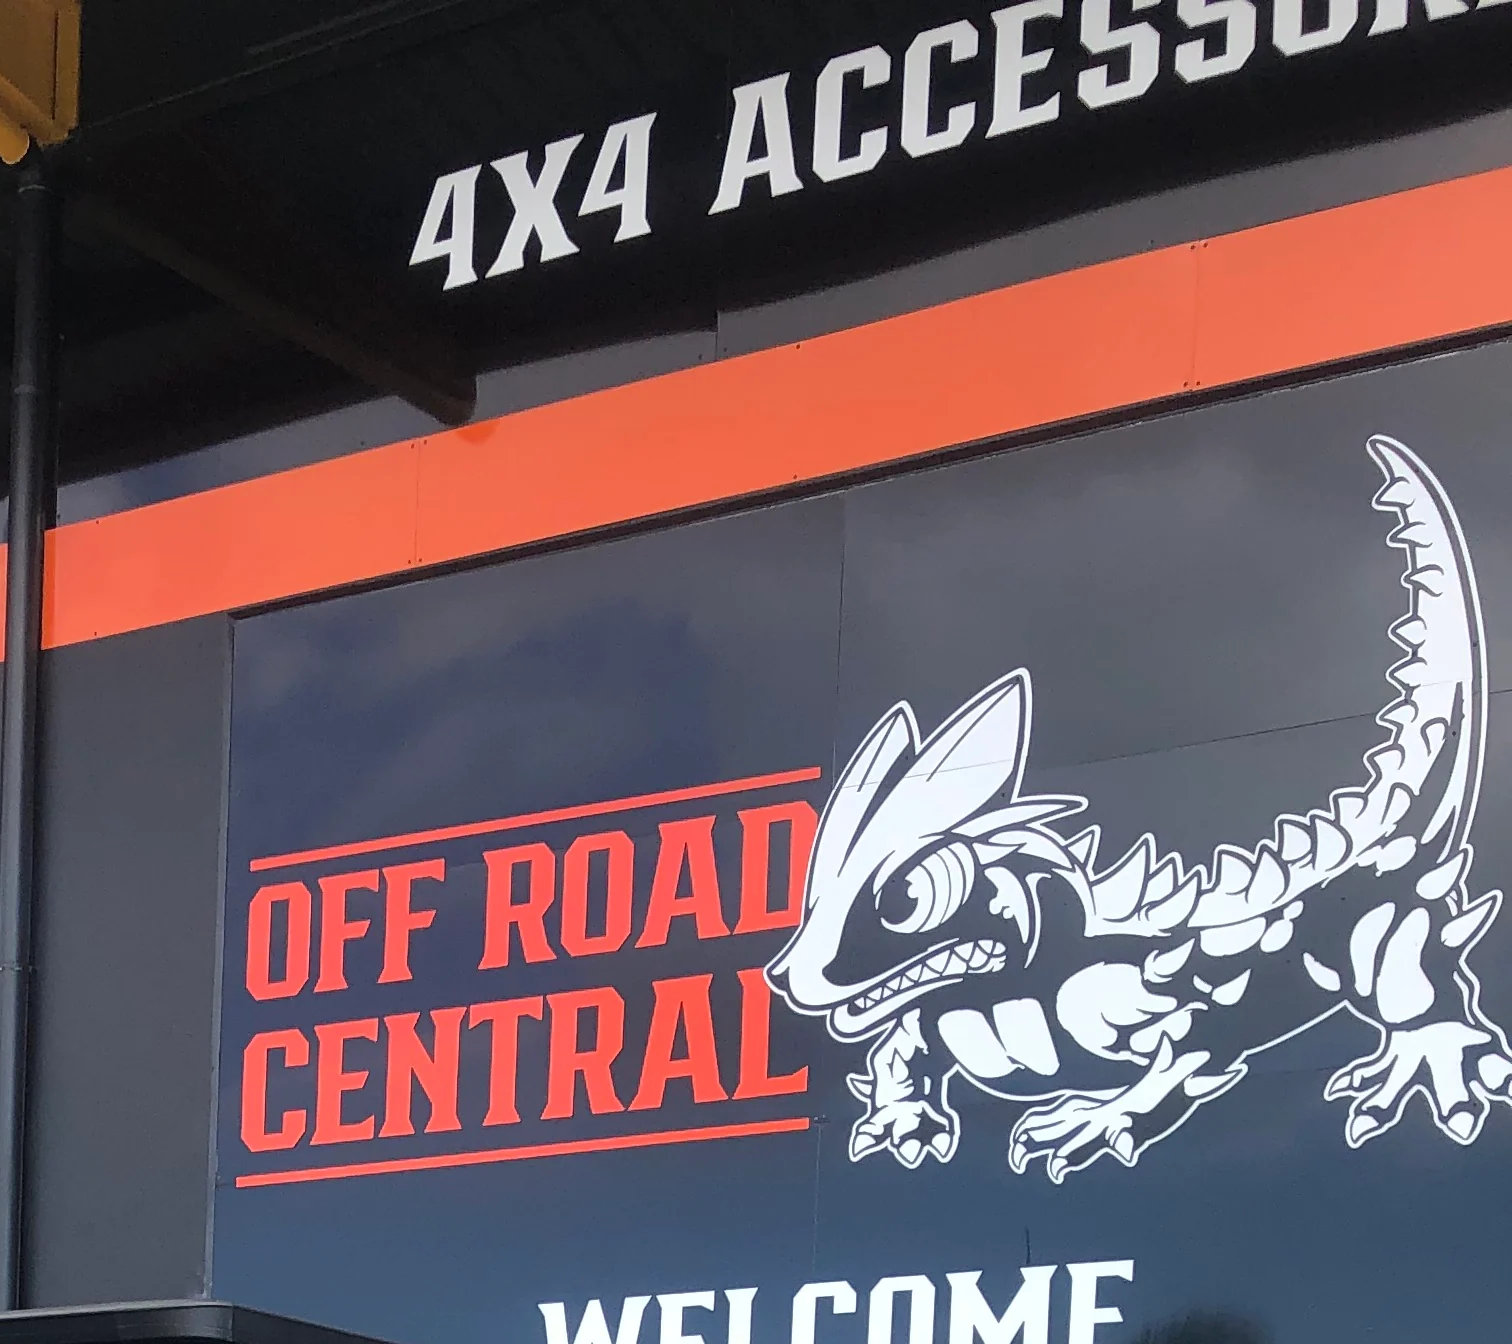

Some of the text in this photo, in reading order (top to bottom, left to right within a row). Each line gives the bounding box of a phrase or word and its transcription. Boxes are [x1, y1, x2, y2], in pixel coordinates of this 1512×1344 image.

[409, 112, 656, 291] 4X4
[246, 801, 819, 1000] OFF ROAD
[240, 968, 808, 1152] CENTRAL
